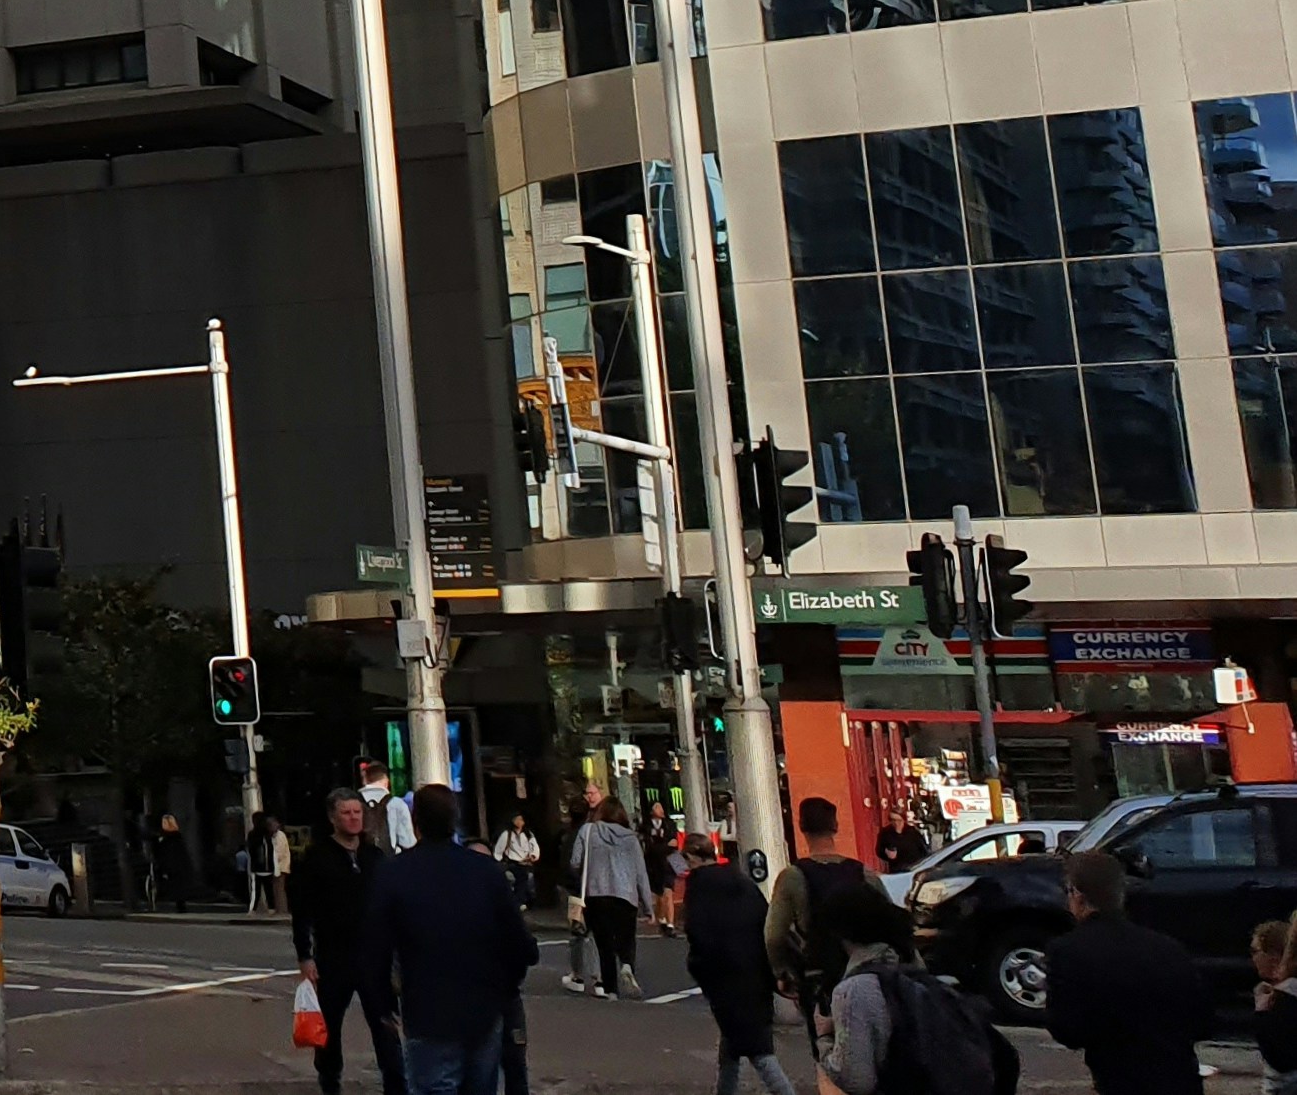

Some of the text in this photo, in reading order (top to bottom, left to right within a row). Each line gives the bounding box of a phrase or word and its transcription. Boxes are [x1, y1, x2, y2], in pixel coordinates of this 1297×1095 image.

[789, 590, 900, 609] Elizabeth St
[1072, 632, 1189, 644] CURRENCY
[894, 642, 930, 657] CITY
[1074, 647, 1192, 660] EXCHANGE
[1117, 732, 1205, 743] EXCHANGE
